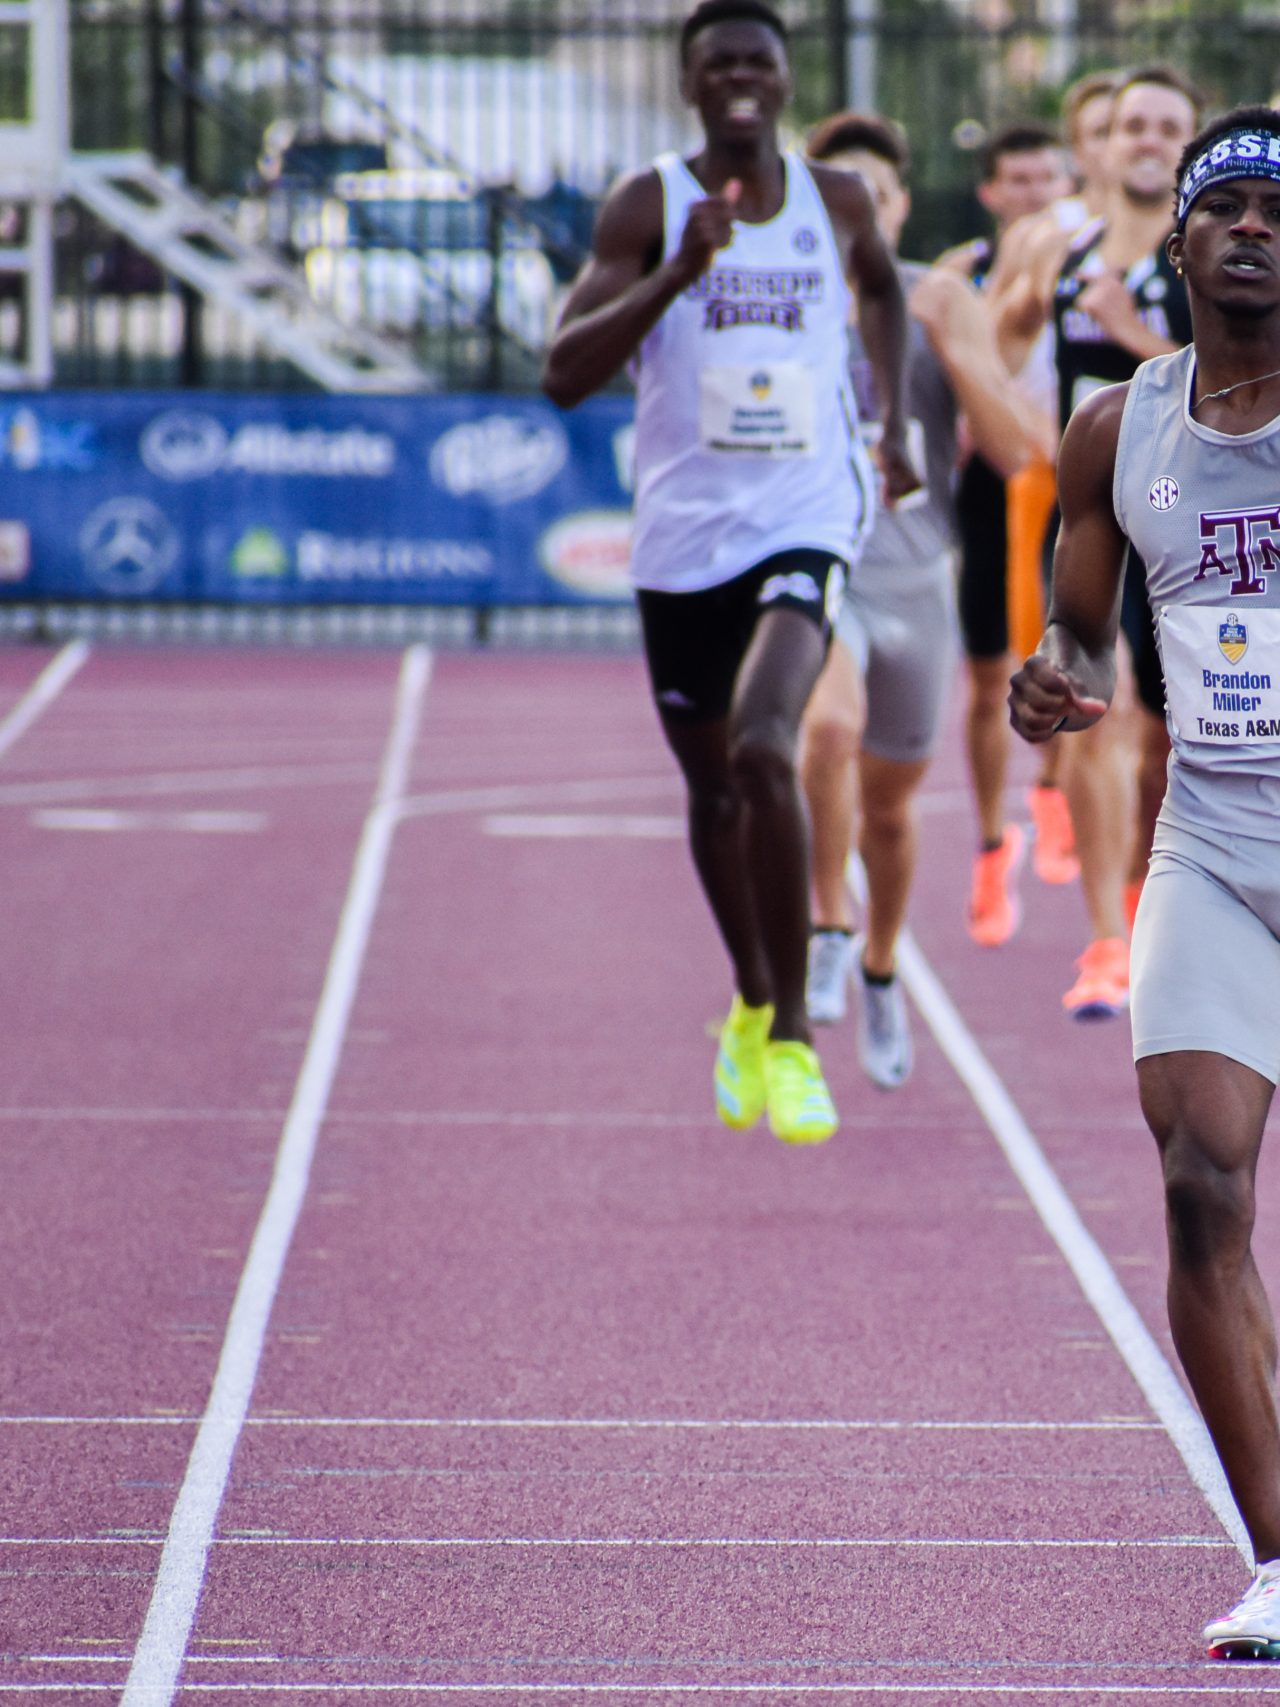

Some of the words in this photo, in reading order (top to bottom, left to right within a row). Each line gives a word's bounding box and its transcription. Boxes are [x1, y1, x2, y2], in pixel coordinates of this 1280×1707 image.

[1151, 478, 1178, 510] SEC
[1202, 669, 1271, 690] Brandon
[1213, 692, 1262, 712] Miller
[1197, 717, 1240, 737] Texas
